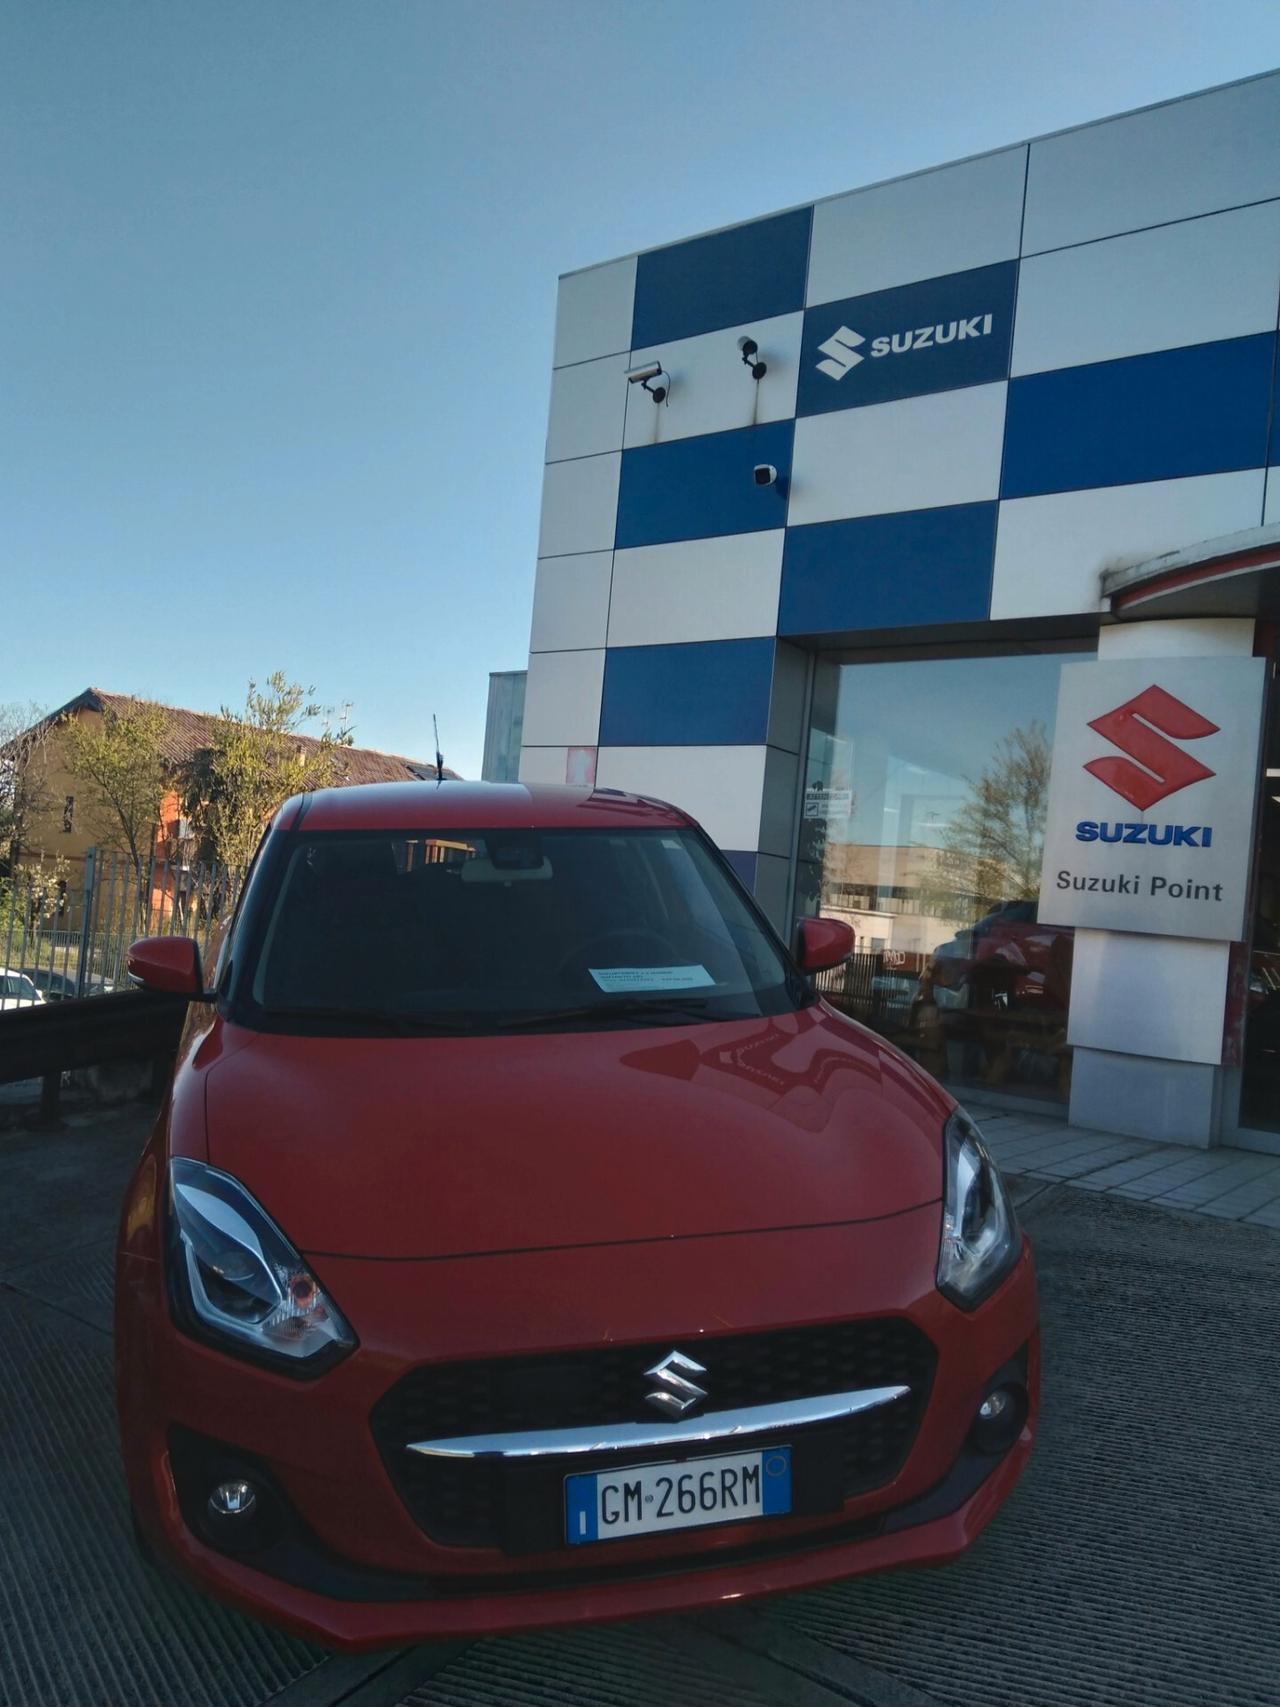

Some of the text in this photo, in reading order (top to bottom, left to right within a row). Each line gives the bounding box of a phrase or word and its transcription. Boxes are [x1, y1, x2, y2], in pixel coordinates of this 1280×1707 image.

[870, 314, 992, 357] SUZUKI
[1075, 821, 1212, 848] SUZUKI
[1056, 870, 1223, 902] Suzuki Point
